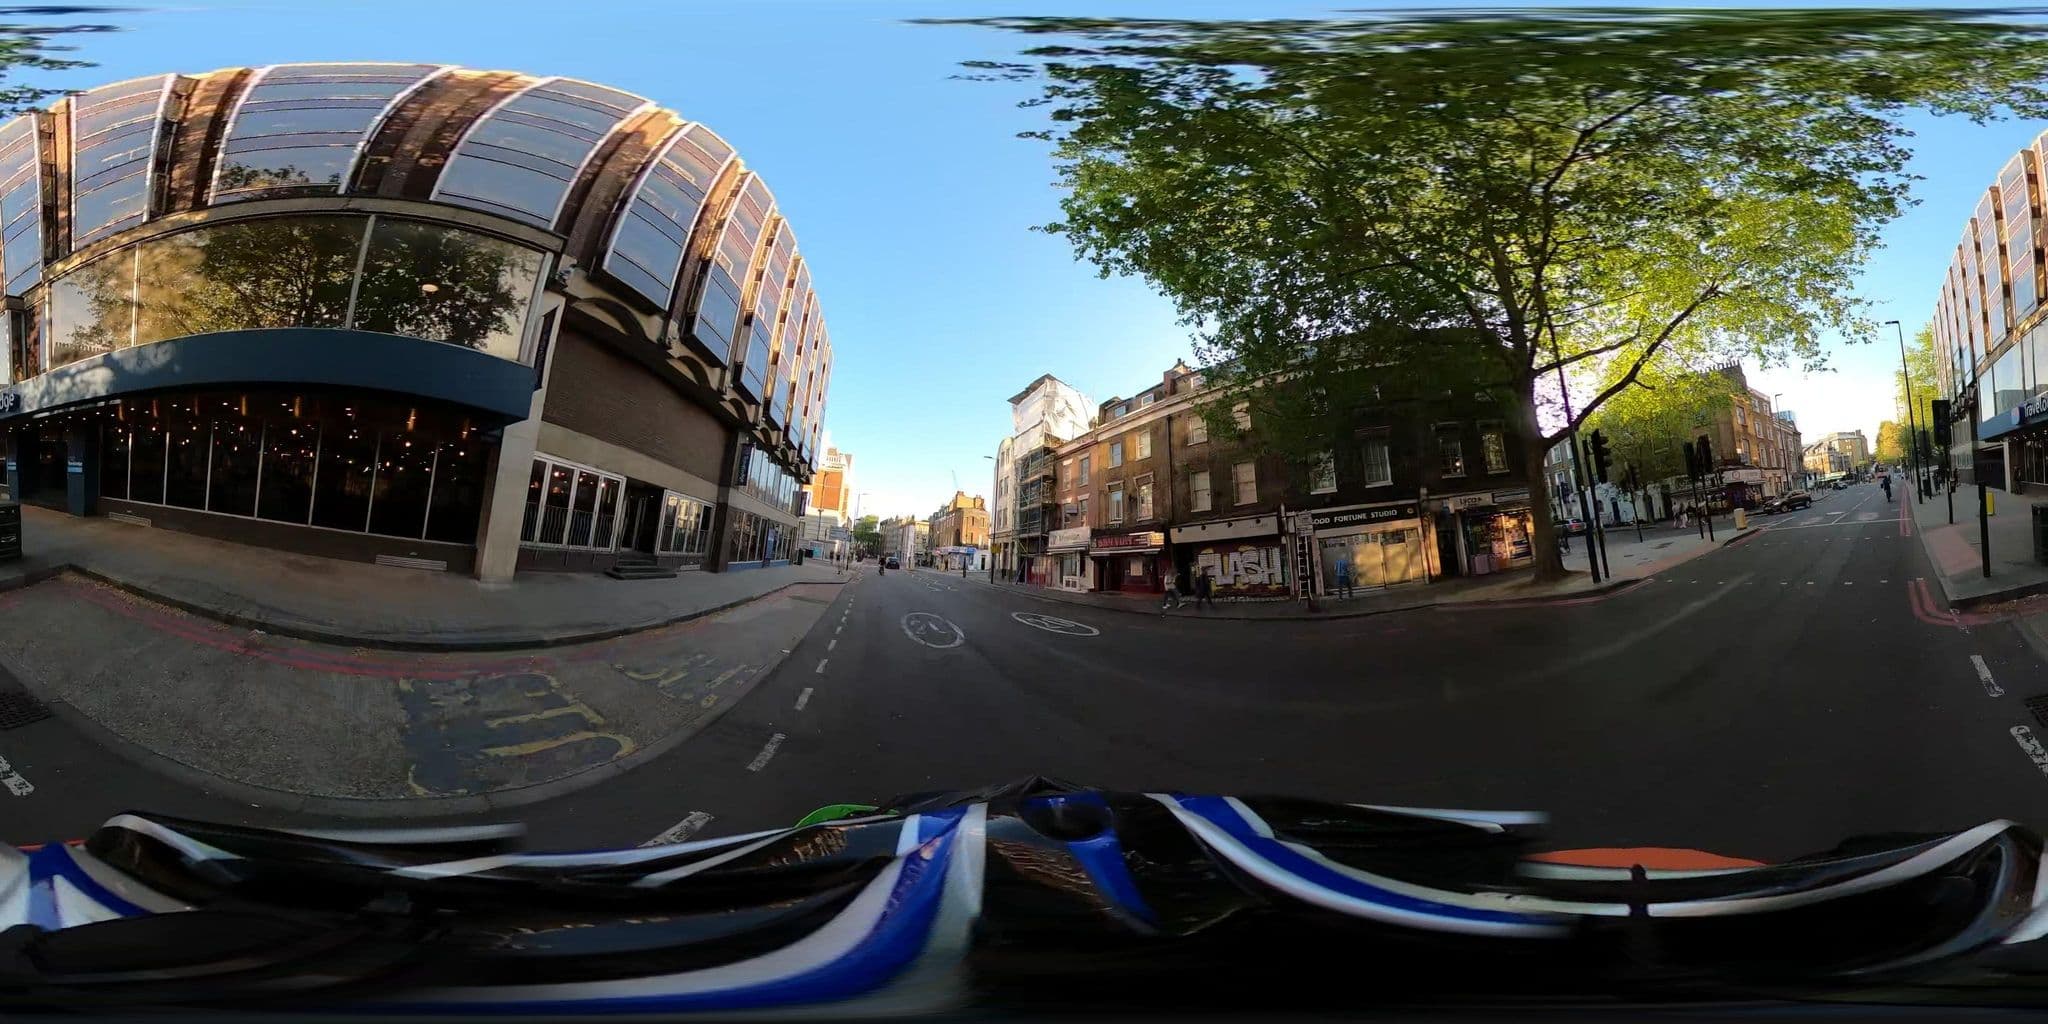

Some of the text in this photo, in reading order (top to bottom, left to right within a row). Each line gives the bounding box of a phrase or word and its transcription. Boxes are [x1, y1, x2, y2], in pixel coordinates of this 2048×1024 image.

[1312, 509, 1397, 525] OOD FORTUNE STUDIO
